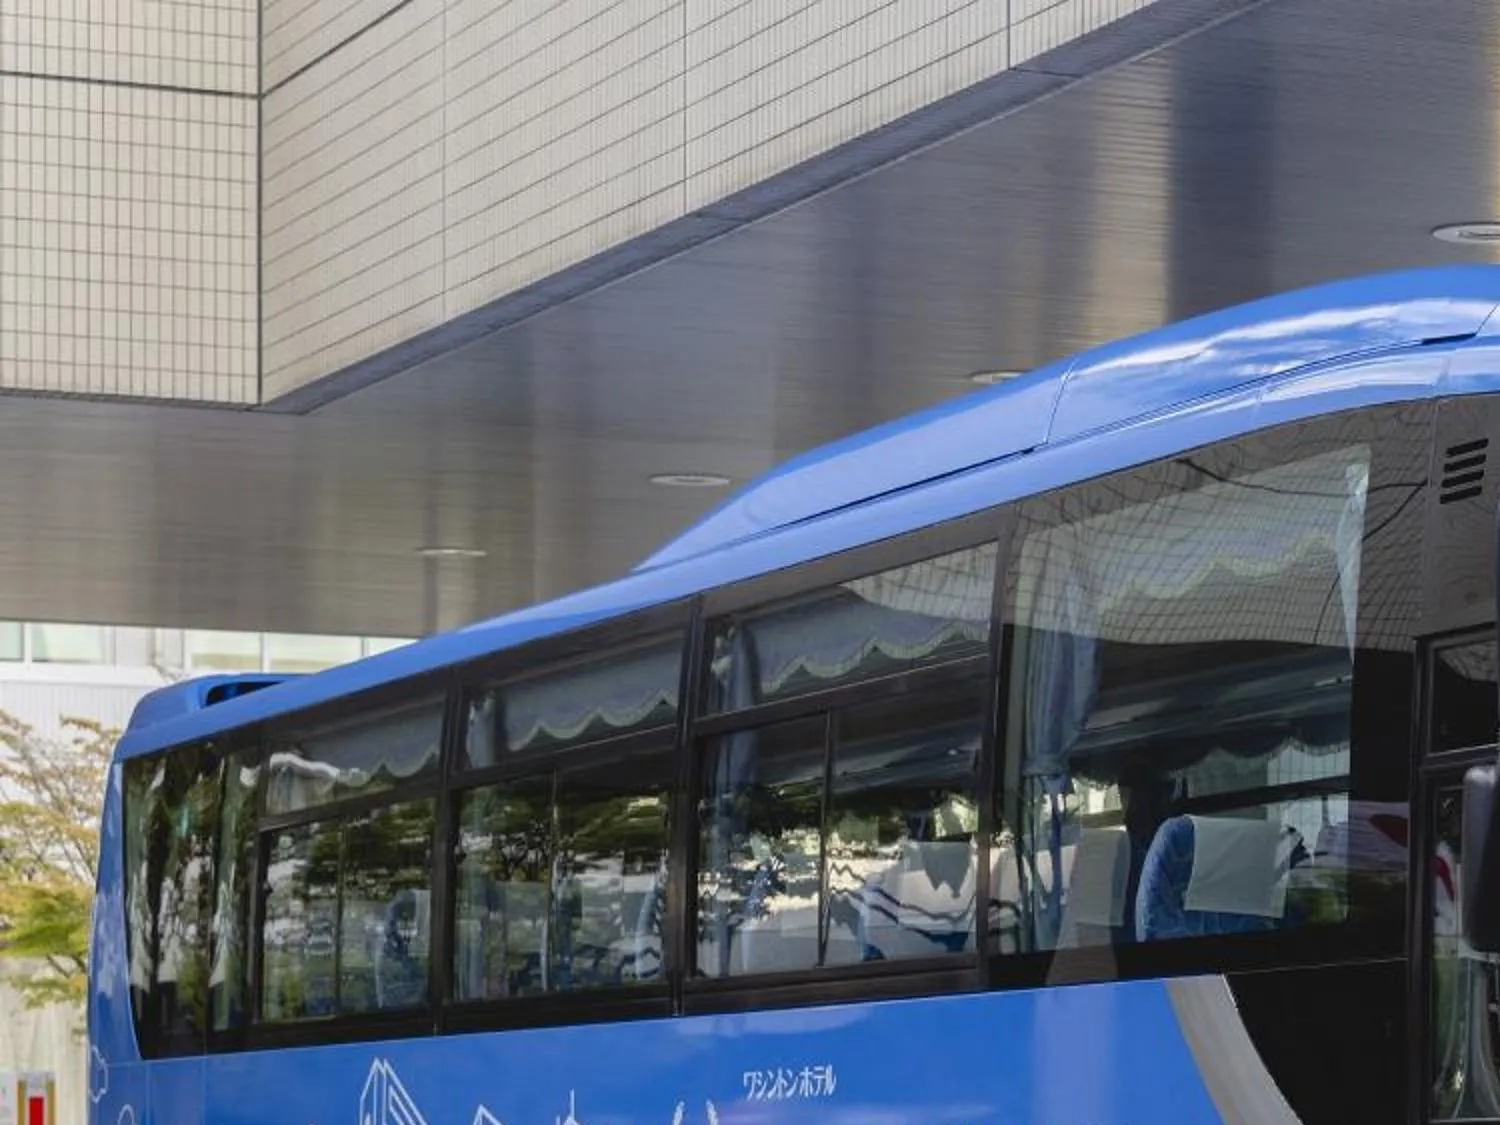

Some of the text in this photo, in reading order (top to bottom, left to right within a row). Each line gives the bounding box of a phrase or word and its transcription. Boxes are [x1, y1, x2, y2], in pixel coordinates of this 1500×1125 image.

[743, 1064, 837, 1100] ワシントンホテル
